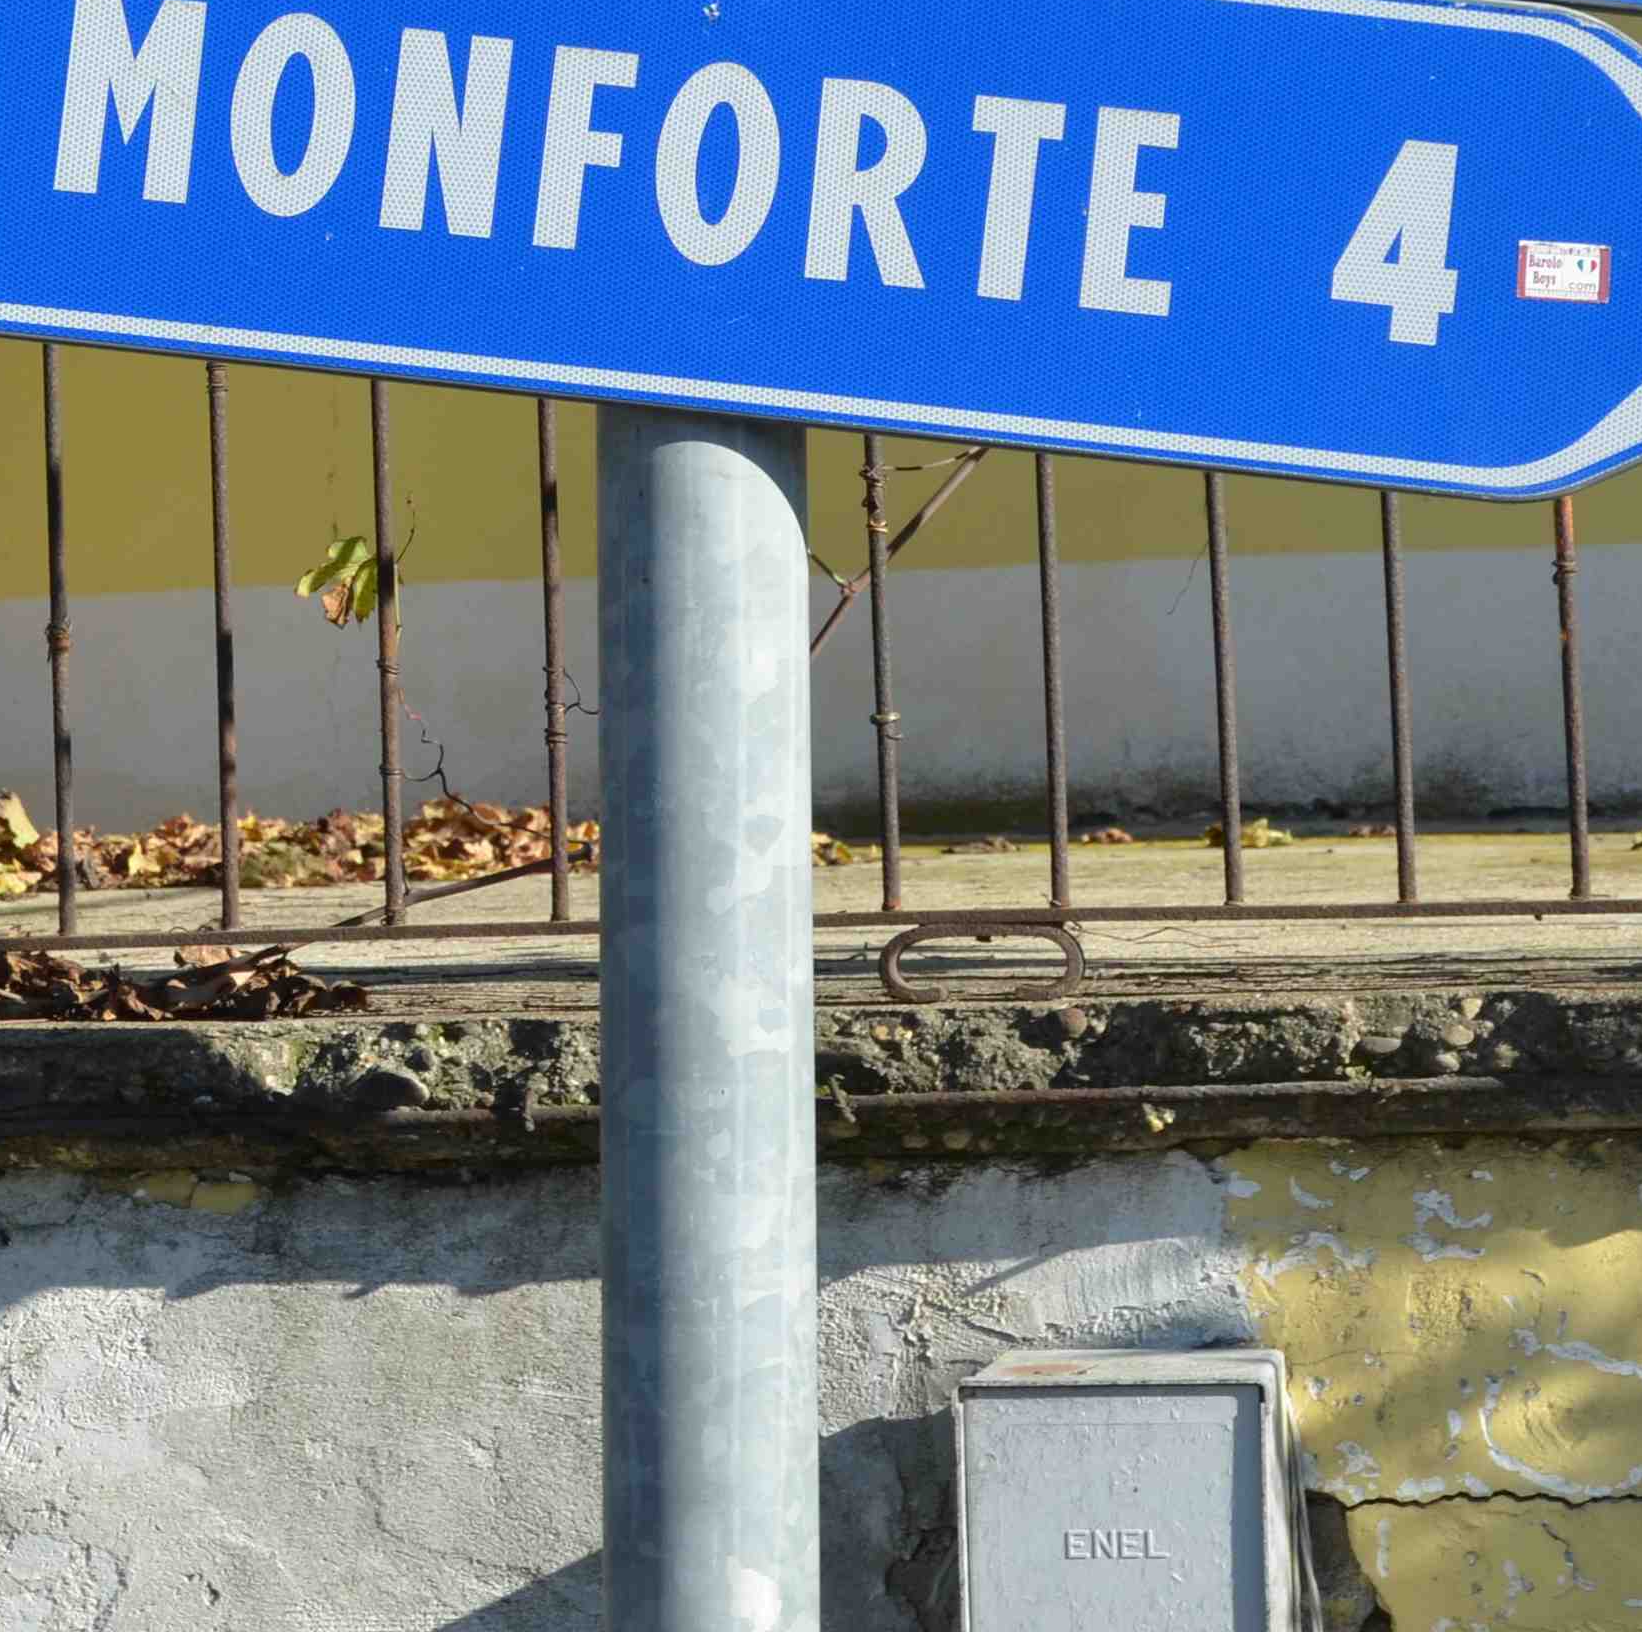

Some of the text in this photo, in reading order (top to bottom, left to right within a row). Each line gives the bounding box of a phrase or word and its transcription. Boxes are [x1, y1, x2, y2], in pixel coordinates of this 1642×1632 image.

[1331, 139, 1459, 346] 4
[1528, 254, 1563, 269] Barolo
[1532, 270, 1556, 288] Boys
[1063, 1528, 1171, 1560] ENEL
